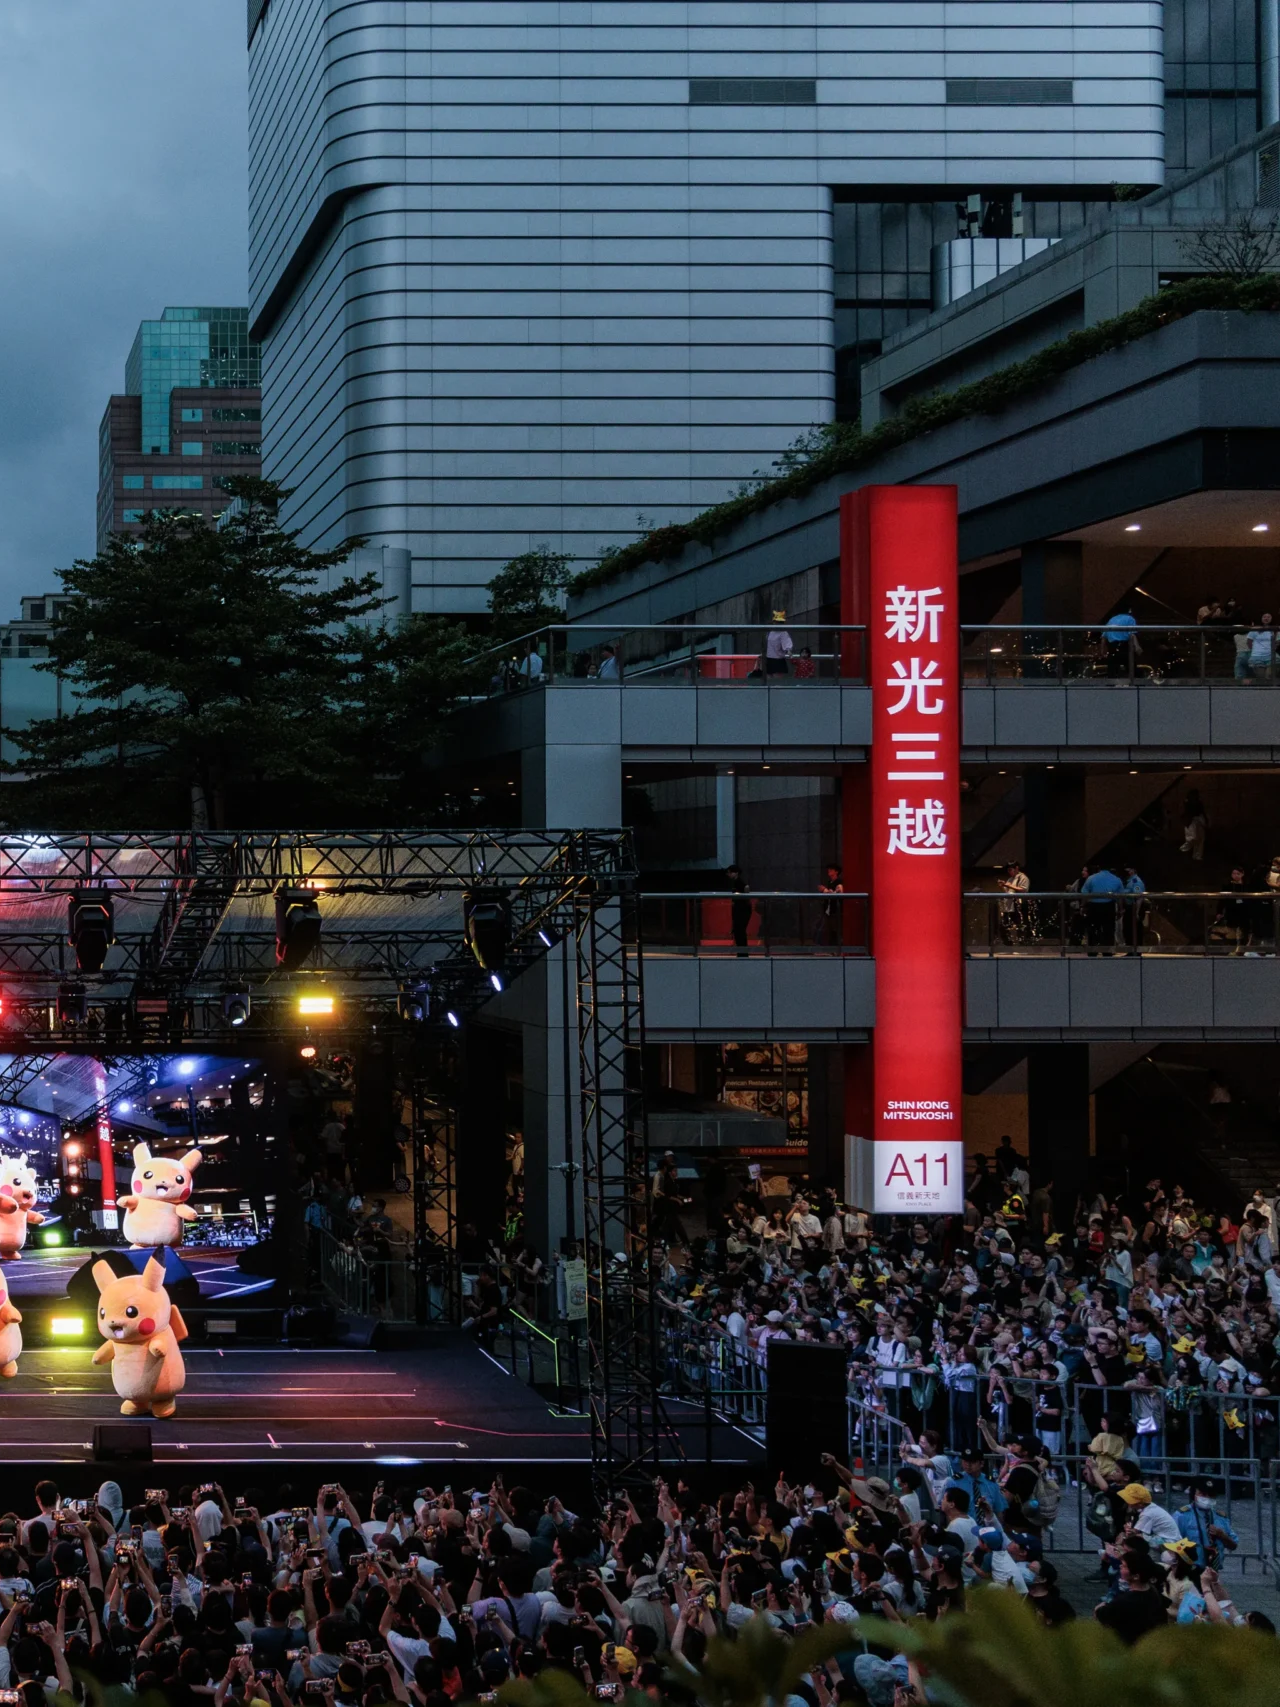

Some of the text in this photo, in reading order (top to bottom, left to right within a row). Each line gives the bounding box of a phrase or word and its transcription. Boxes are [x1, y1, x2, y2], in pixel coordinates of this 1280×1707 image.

[884, 585, 947, 855] 新光三越
[887, 1101, 949, 1110] SHIN KONG
[883, 1111, 953, 1120] MITSUKOSHI
[884, 1153, 948, 1187] A11
[897, 1192, 940, 1200] 信義新天地
